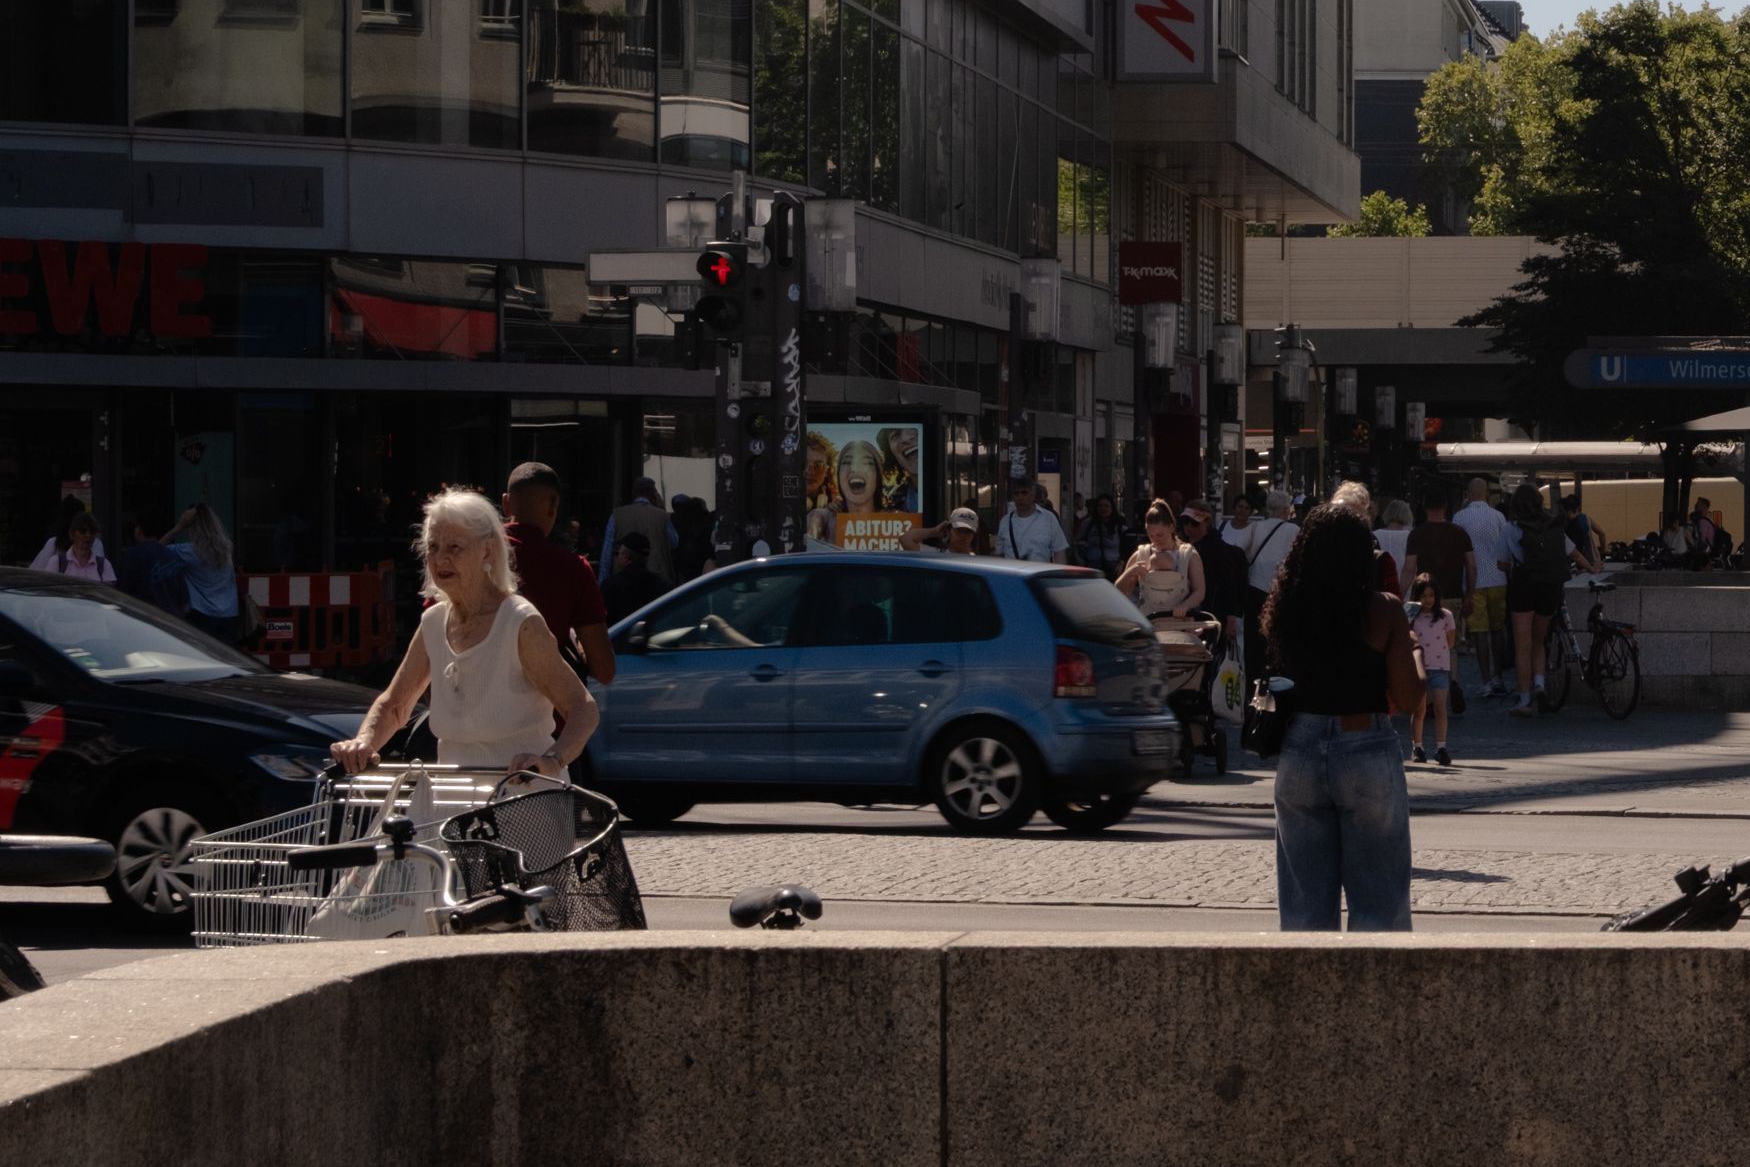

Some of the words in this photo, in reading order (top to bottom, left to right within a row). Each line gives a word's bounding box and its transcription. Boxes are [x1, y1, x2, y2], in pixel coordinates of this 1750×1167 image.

[0, 238, 214, 339] EWE
[1601, 355, 1621, 382] U
[845, 520, 913, 536] ABITUR?
[843, 538, 904, 551] MACHE
